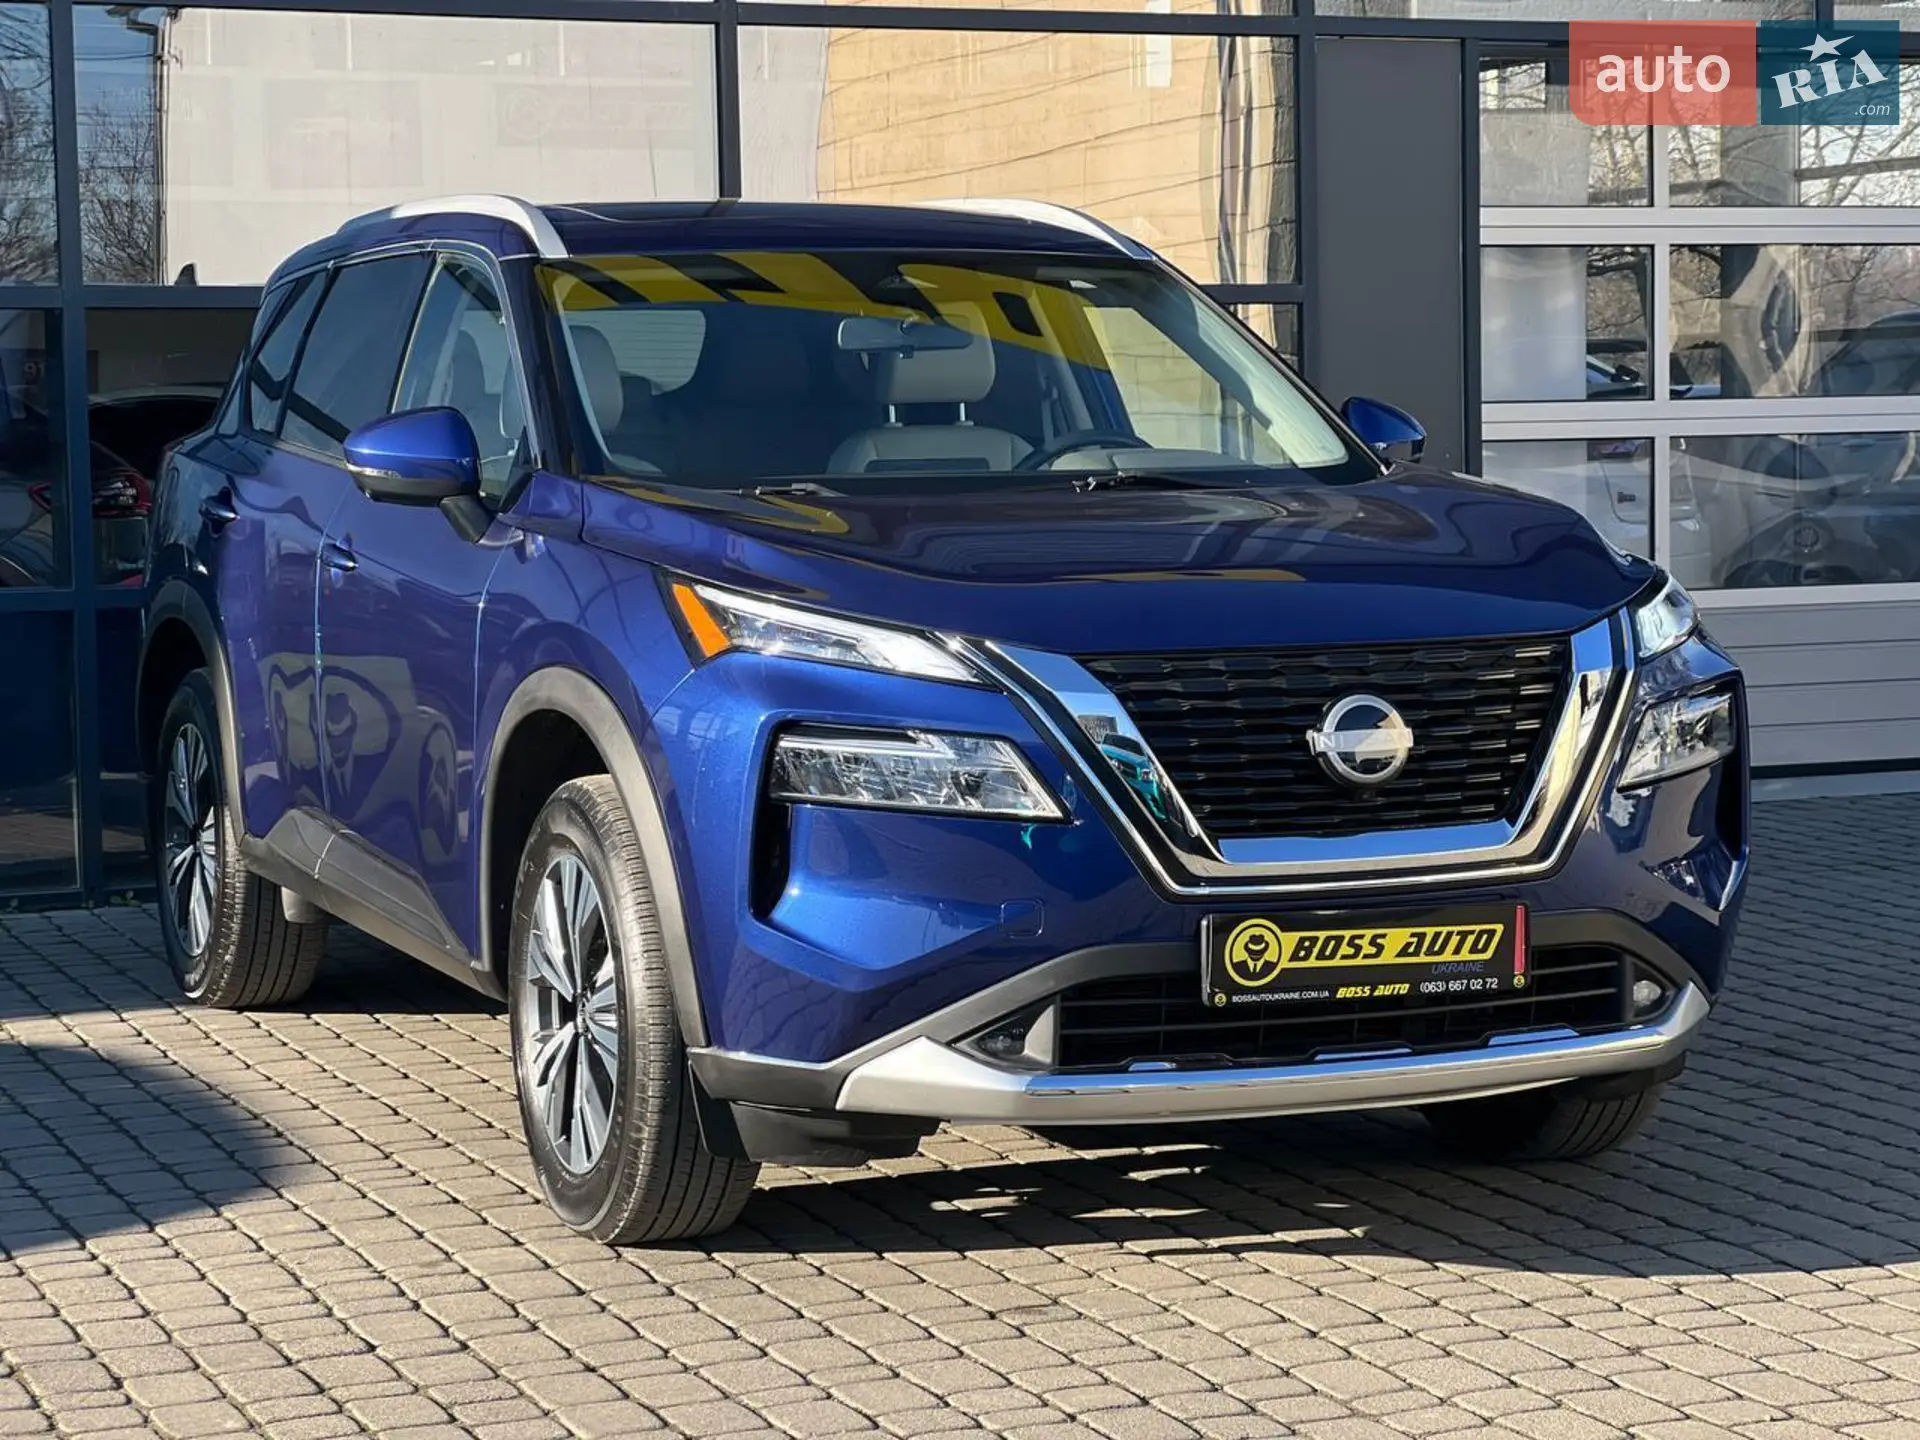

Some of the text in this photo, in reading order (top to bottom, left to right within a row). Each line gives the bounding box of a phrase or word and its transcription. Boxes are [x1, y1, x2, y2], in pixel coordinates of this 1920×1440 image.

[1289, 929, 1497, 962] BOSS AUTO
[1432, 962, 1486, 974] UKRAINE
[1336, 986, 1371, 998] BOSS
[1373, 984, 1410, 996] AUTO
[1420, 980, 1446, 993] (063)
[1449, 979, 1467, 991] 667
[1469, 978, 1483, 990] 02
[1485, 977, 1499, 989] 72
